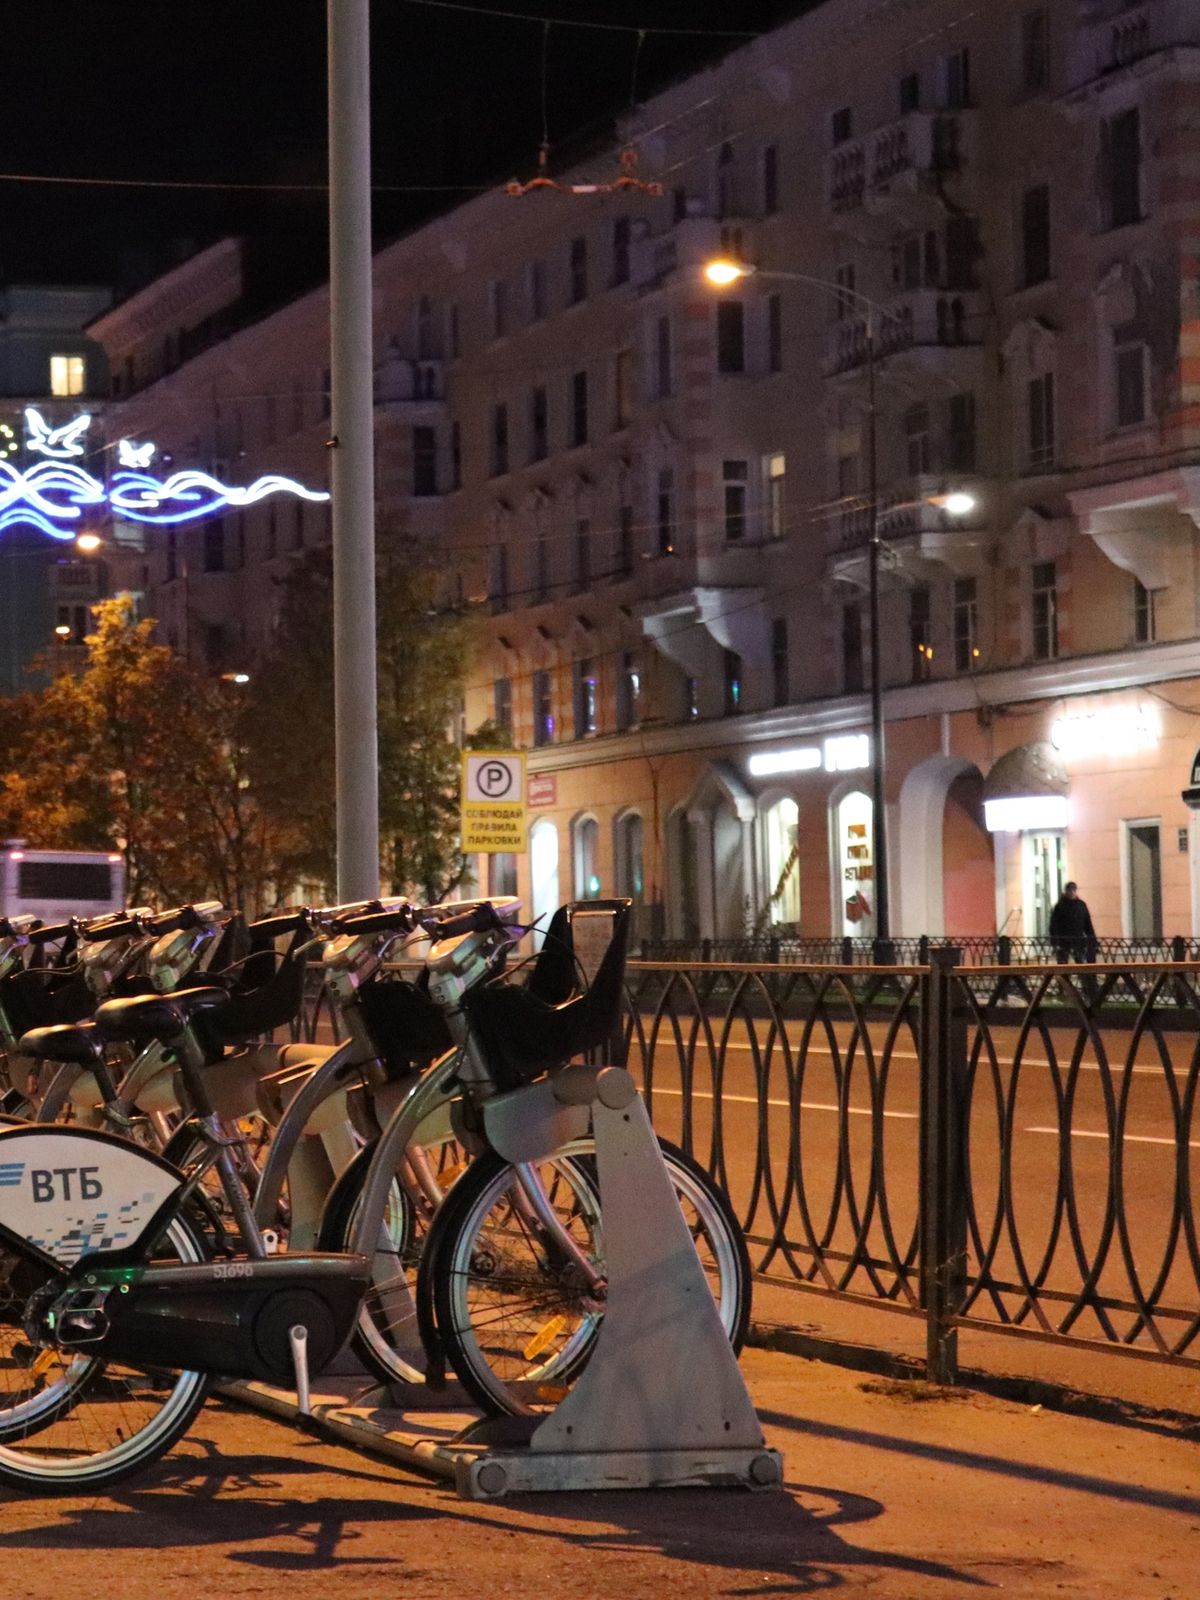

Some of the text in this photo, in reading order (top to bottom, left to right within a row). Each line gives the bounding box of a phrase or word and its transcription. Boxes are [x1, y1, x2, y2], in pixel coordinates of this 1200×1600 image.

[487, 768, 503, 790] P
[466, 808, 523, 819] СОБЛЮДАЙ
[471, 823, 518, 832] ПРАВИЛА
[467, 836, 522, 845] ПАРКОВКИ
[31, 1166, 103, 1203] ВТБ
